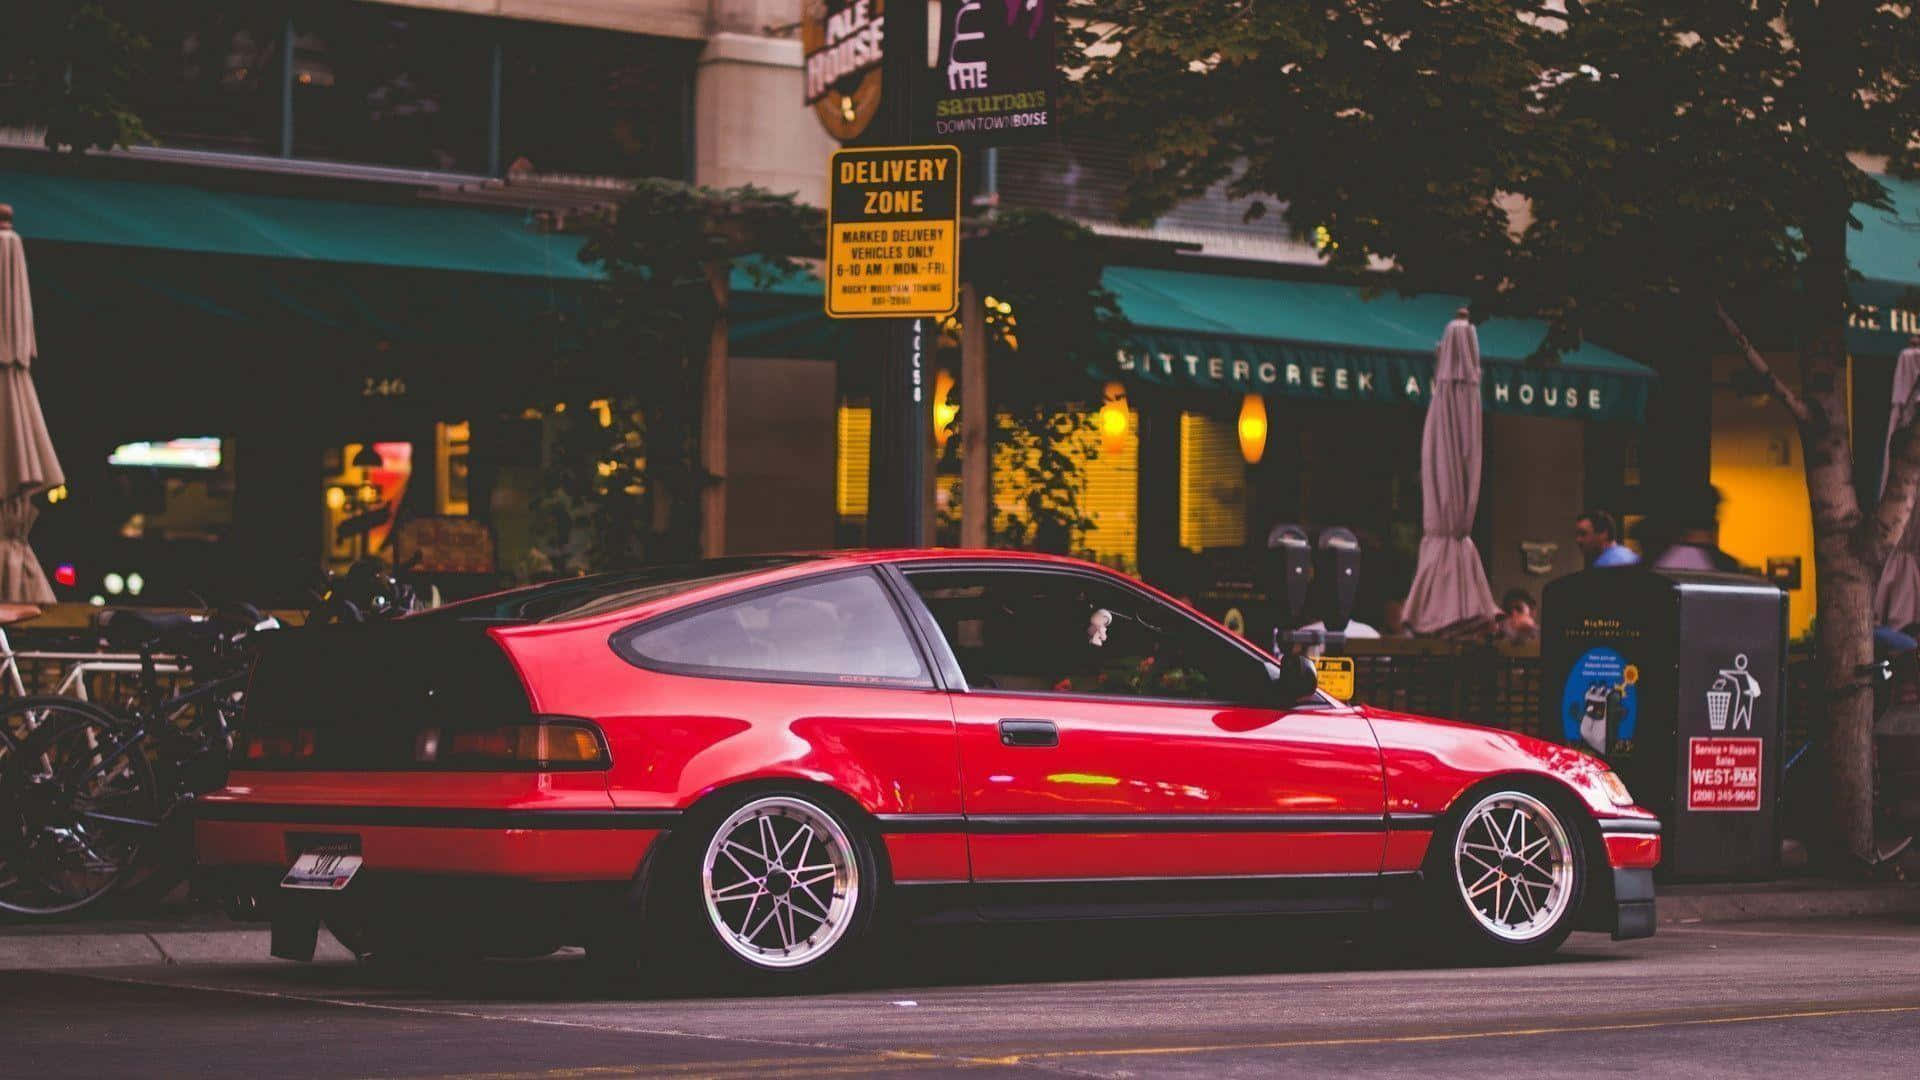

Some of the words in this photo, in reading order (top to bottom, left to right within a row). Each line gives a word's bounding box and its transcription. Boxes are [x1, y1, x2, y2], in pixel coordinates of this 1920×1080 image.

[947, 61, 988, 91] THE
[840, 157, 949, 185] DELIVERY
[864, 189, 924, 215] ZONE
[842, 230, 888, 244] MARKED
[892, 228, 944, 242] DELIVERY
[851, 246, 903, 260] VEHICLES
[908, 245, 935, 259] ONLY
[866, 262, 882, 276] AM
[1495, 383, 1601, 410] HOUSE
[1695, 743, 1722, 756] Service
[1728, 743, 1757, 757] Repairs
